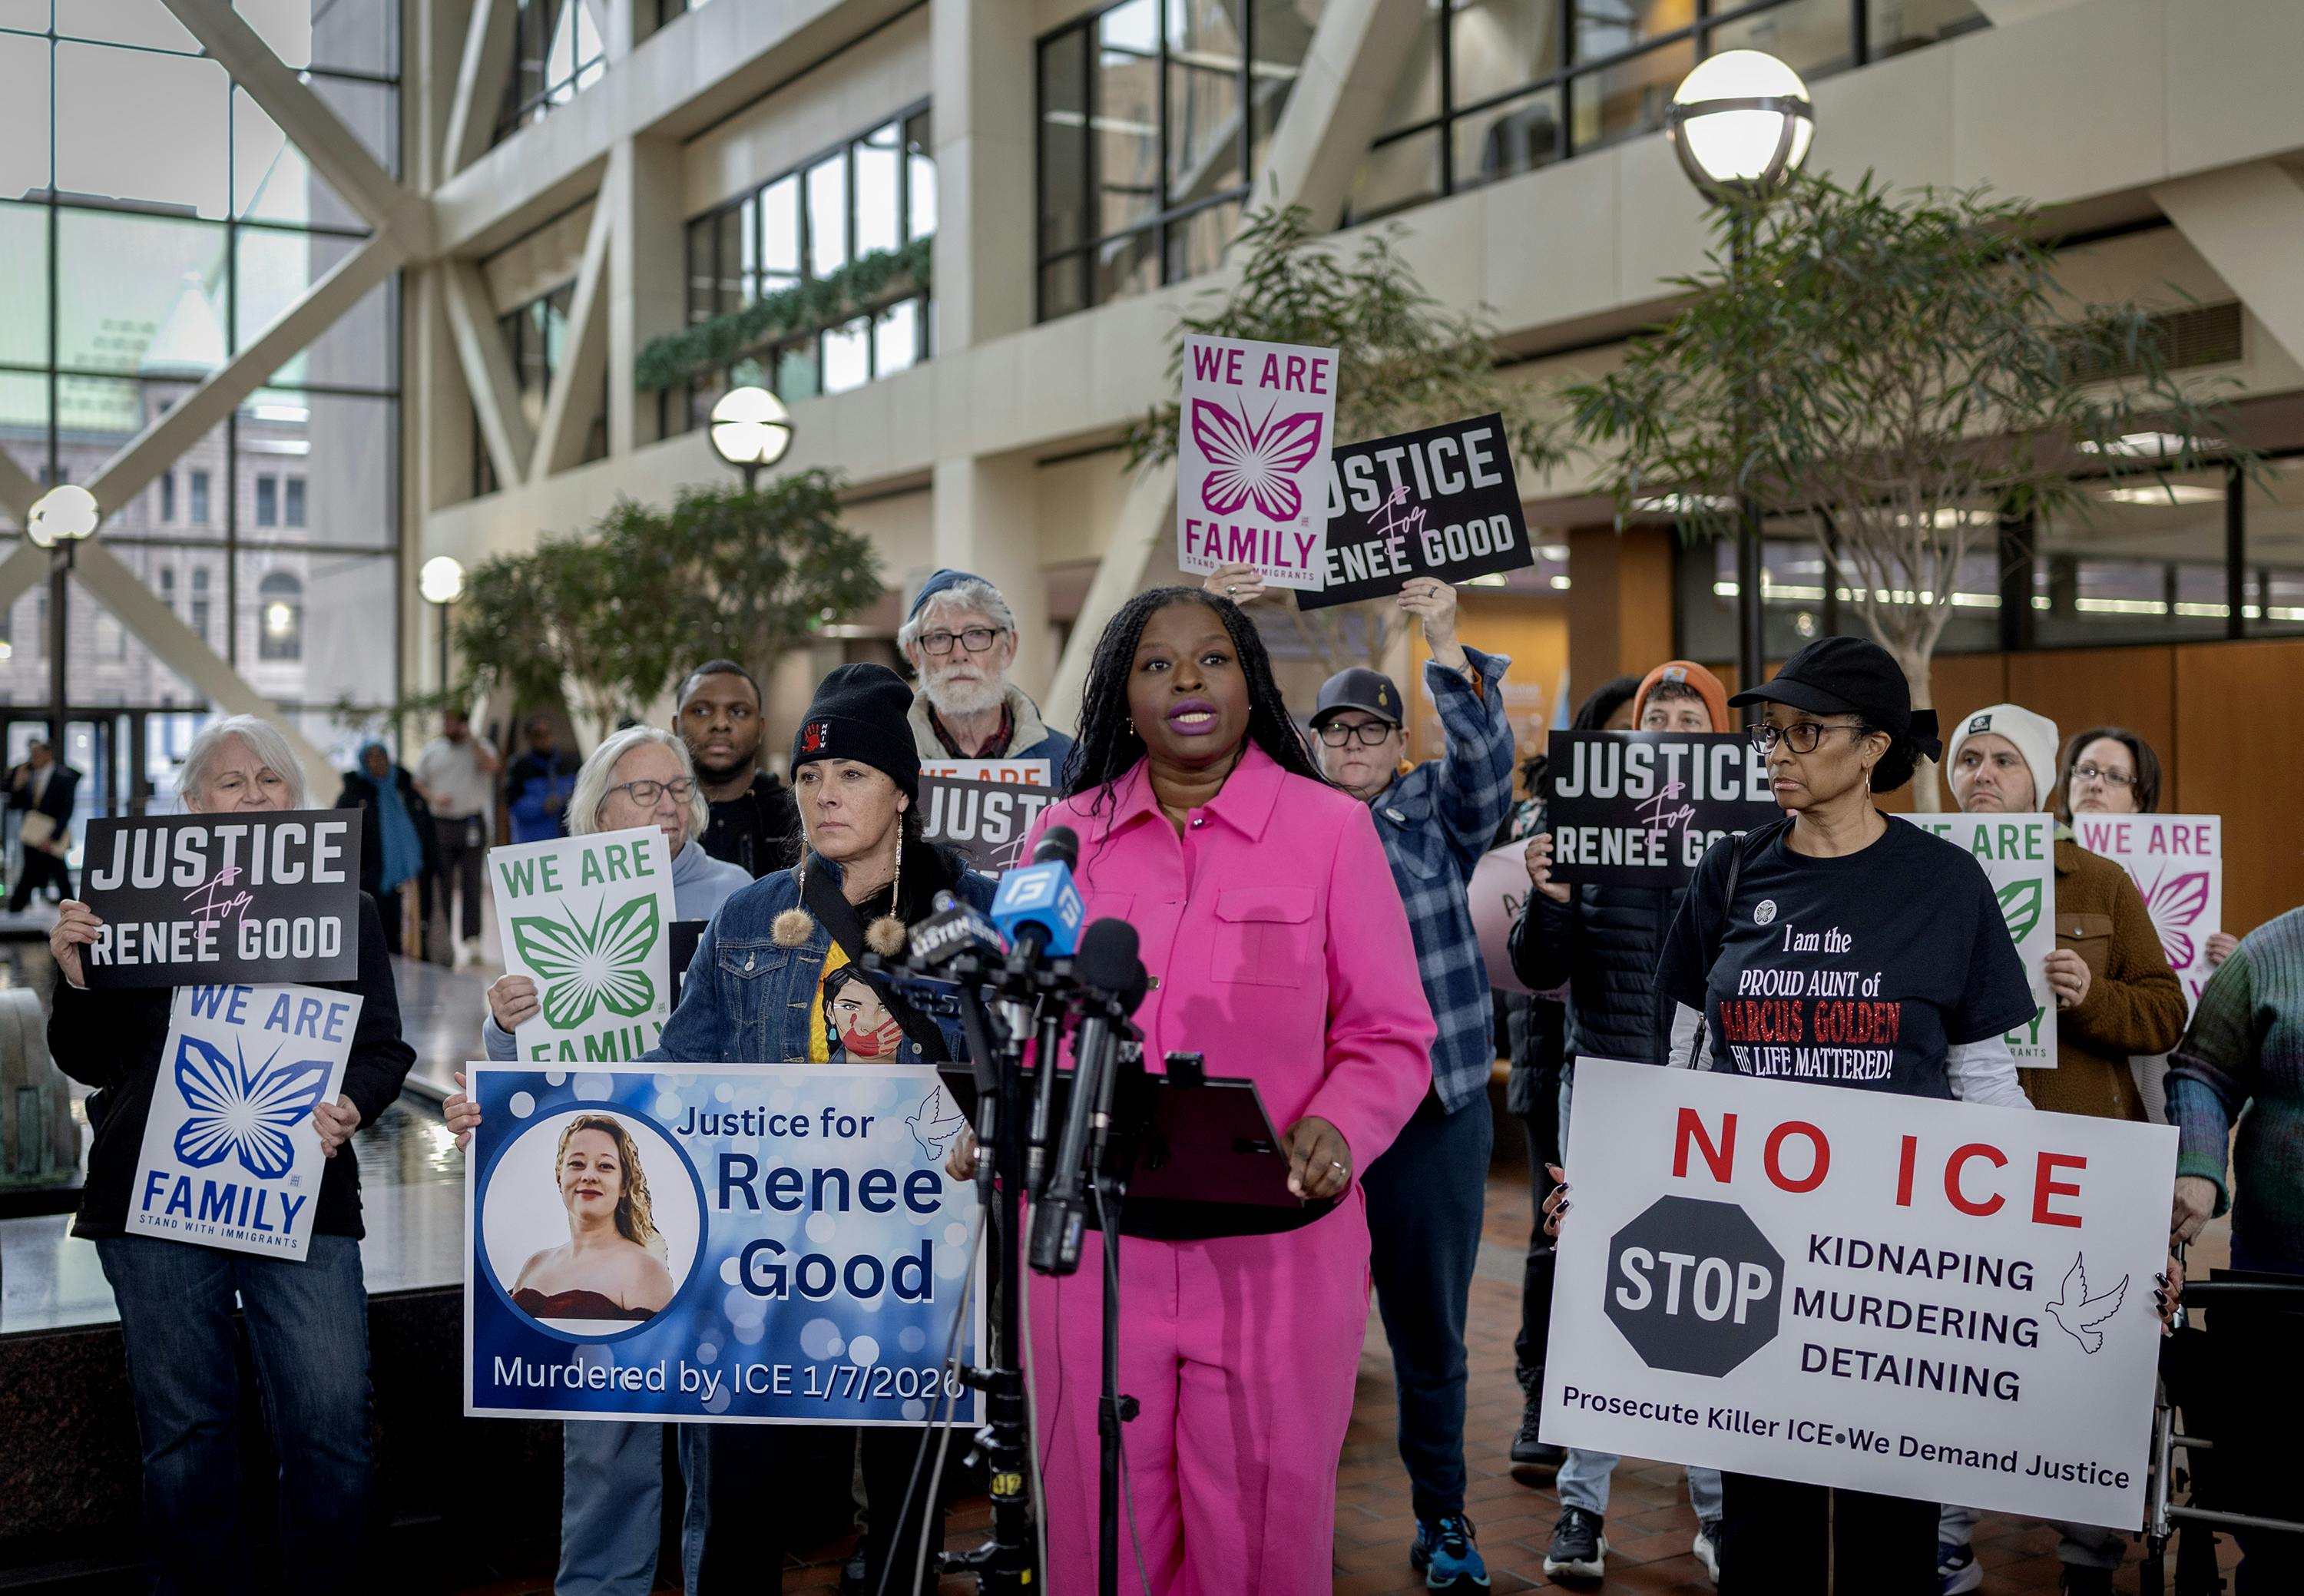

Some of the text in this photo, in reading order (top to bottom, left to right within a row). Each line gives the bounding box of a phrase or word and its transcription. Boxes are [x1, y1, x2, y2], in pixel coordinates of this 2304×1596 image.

[1193, 345, 1329, 396] WE ARE
[1328, 427, 1503, 519] STICE
[1187, 518, 1317, 569] FAMILY
[1187, 556, 1215, 568] STAND
[1252, 566, 1315, 581] MMIGRANTS
[1324, 514, 1515, 586] ENEE GOOD
[1555, 741, 1776, 802] JUSTICE
[922, 786, 1060, 843] JUST
[1971, 824, 2044, 860] ARE
[2084, 823, 2212, 856] WE ARE
[91, 821, 348, 891] JUSTICE
[499, 839, 655, 899] WE ARE
[1556, 826, 1669, 867] RENEE
[91, 916, 341, 965] RENEE GOOD
[1783, 925, 1852, 953] I am the
[1737, 969, 1882, 998] PROUD AUNT of
[190, 985, 350, 1044] WE ARE
[1814, 999, 1901, 1044] GOLDEN
[1753, 1047, 1791, 1076] LIFE
[1795, 1047, 1894, 1080] MATTERED!
[2010, 1048, 2047, 1058] RANTS
[676, 1107, 875, 1138] Justice for
[718, 1153, 943, 1214] Renee
[1673, 1107, 2087, 1228] NO ICE
[139, 1214, 298, 1248] STAND WITH IMMIGRANTS
[142, 1170, 307, 1235] FAMILY
[740, 1239, 934, 1300] Good
[1616, 1247, 1773, 1324] STOP
[1808, 1233, 2034, 1291] KIDNAPING
[1793, 1286, 2040, 1348] MURDERING
[494, 1356, 965, 1401] Murdered by ICE 1/7/2026
[1801, 1343, 2020, 1402] DETAINING
[1562, 1386, 1700, 1425] Prosecute
[1707, 1407, 1780, 1439] Killer
[1899, 1435, 2018, 1474] Demand
[2025, 1454, 2130, 1489] Justice
